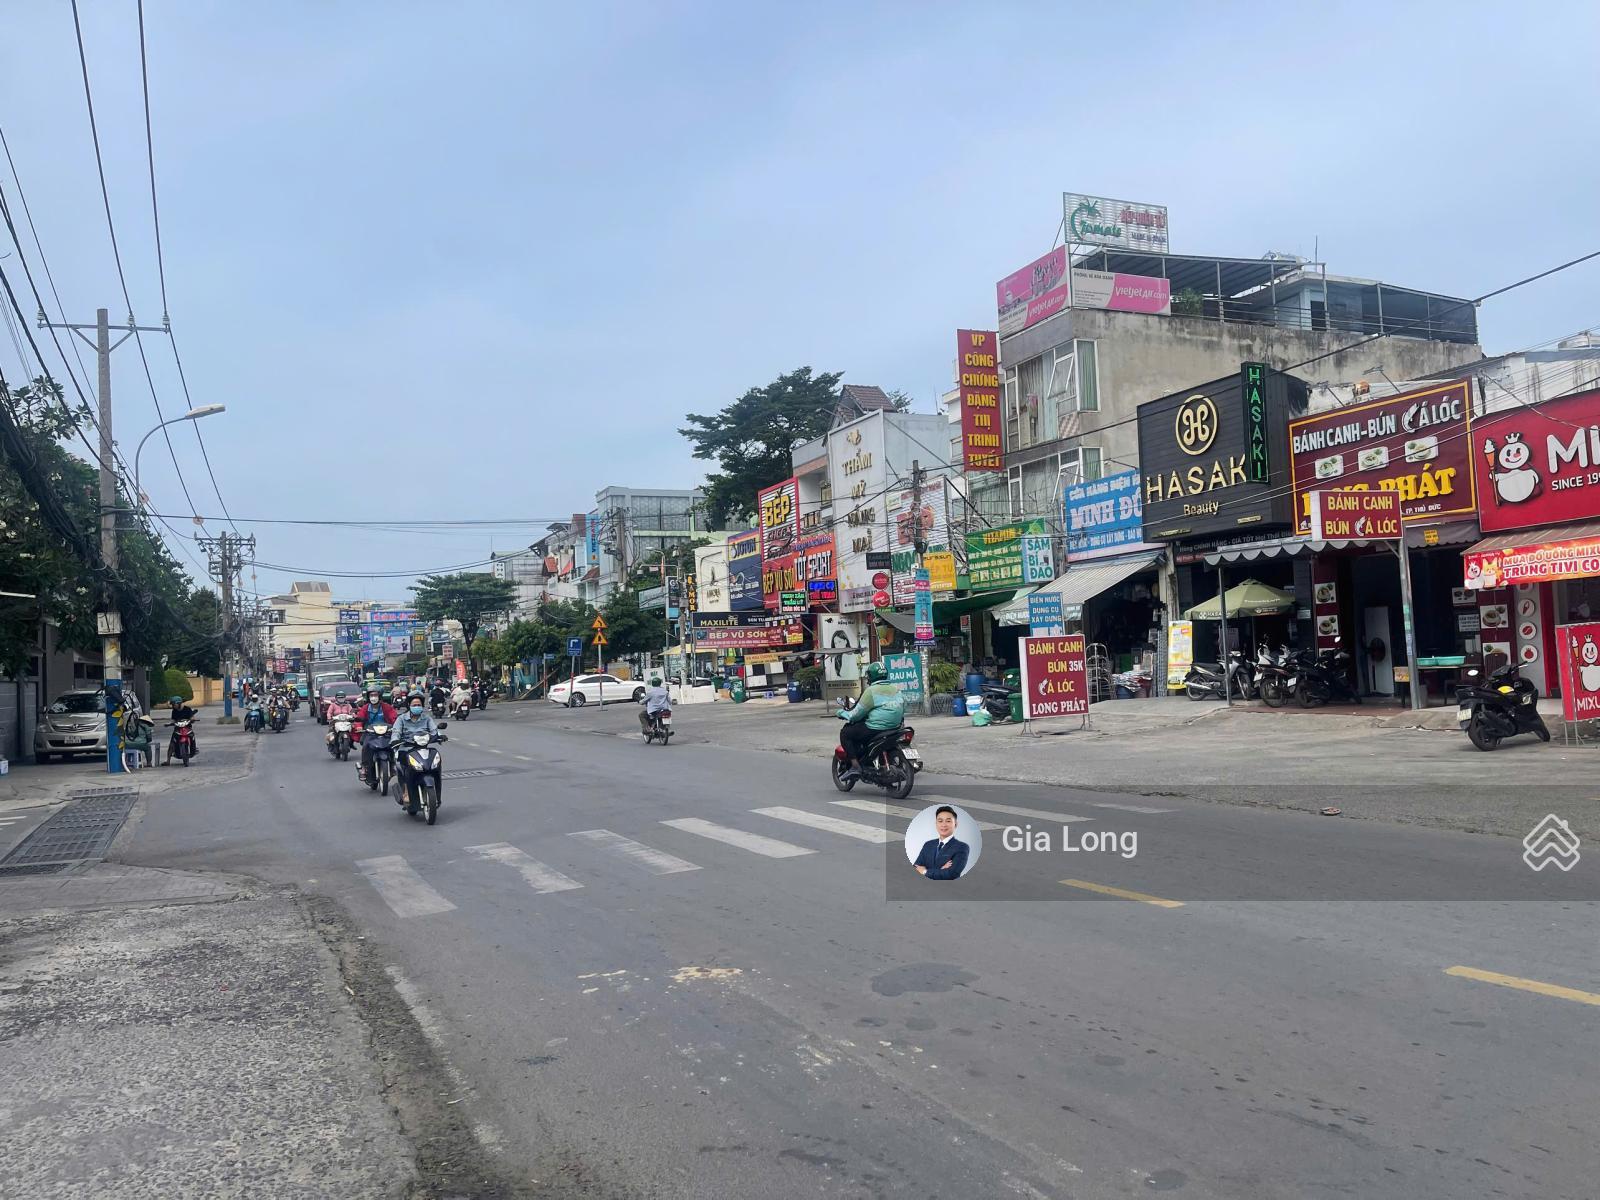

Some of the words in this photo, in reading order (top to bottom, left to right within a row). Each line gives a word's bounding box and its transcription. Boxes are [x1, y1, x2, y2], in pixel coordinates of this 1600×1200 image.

[971, 333, 985, 347] VP
[965, 352, 994, 368] CÔNG
[962, 371, 998, 387] CHỨNG
[967, 392, 996, 410] ĐẶNG
[974, 414, 991, 430] THỊ
[1249, 367, 1264, 478] HASAKI
[1293, 429, 1325, 454] BÁNH
[1432, 396, 1461, 424] LÓC
[967, 433, 999, 447] TRINH
[842, 448, 872, 476] THẨM
[968, 449, 999, 467] TUYẾT
[1146, 454, 1247, 504] HASAK
[1551, 474, 1584, 491] SINCE
[764, 486, 791, 527] BẾP
[1183, 501, 1220, 516] Beauty
[1327, 493, 1359, 510] BÁNH
[1363, 496, 1393, 510] CANH
[1070, 499, 1115, 530] MINH
[1326, 517, 1349, 535] BÚN
[1377, 517, 1397, 534] LÓC
[807, 551, 832, 579] SPORT
[1029, 551, 1039, 566] BÍ
[1503, 556, 1527, 566] MUA
[1528, 550, 1543, 562] ĐỒ
[1545, 547, 1575, 559] UỐNG
[1030, 567, 1053, 580] ĐAO
[1503, 564, 1548, 578] TRÚNG
[1551, 560, 1578, 574] TIVI
[763, 569, 774, 594] BẾP
[774, 566, 784, 591] VŨ
[700, 619, 739, 627] MAXILITE
[709, 629, 728, 639] BẾP
[730, 628, 744, 639] VŨ
[747, 629, 767, 638] SƠN
[1029, 641, 1055, 655] BÁNH
[1058, 641, 1083, 654] CANH
[1047, 658, 1067, 673] BÚN
[1069, 660, 1083, 671] 35K
[890, 671, 904, 680] RAU
[906, 669, 918, 679] MÁ
[1057, 678, 1074, 693] LÓC
[1032, 701, 1058, 715] LONG
[1061, 697, 1086, 713] PHÁT
